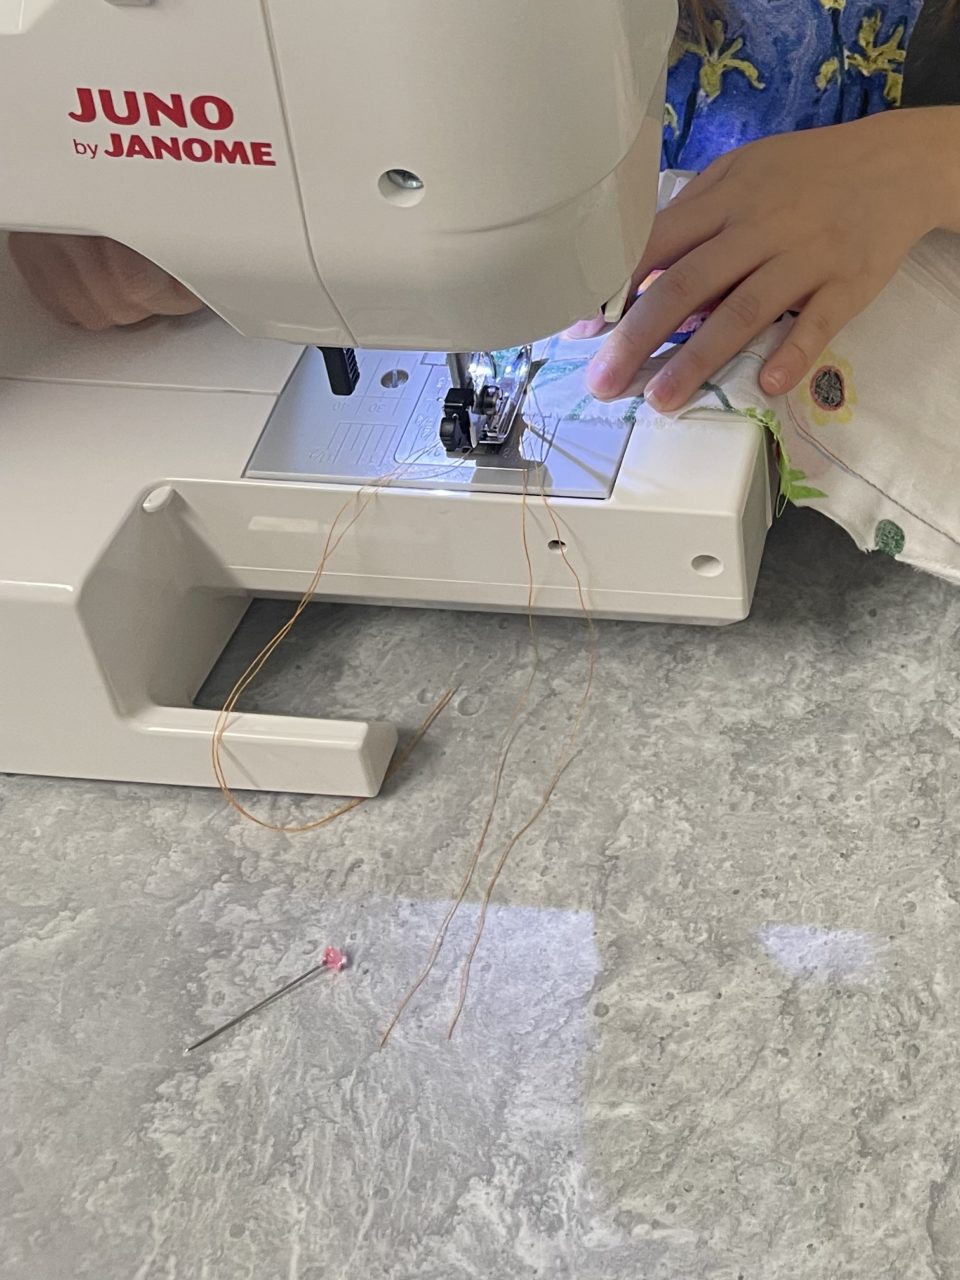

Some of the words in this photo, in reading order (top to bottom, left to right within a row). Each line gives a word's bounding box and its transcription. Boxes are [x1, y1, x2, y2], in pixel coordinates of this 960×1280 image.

[68, 87, 234, 131] JUNO
[73, 139, 98, 159] by
[104, 133, 276, 166] JANOME
